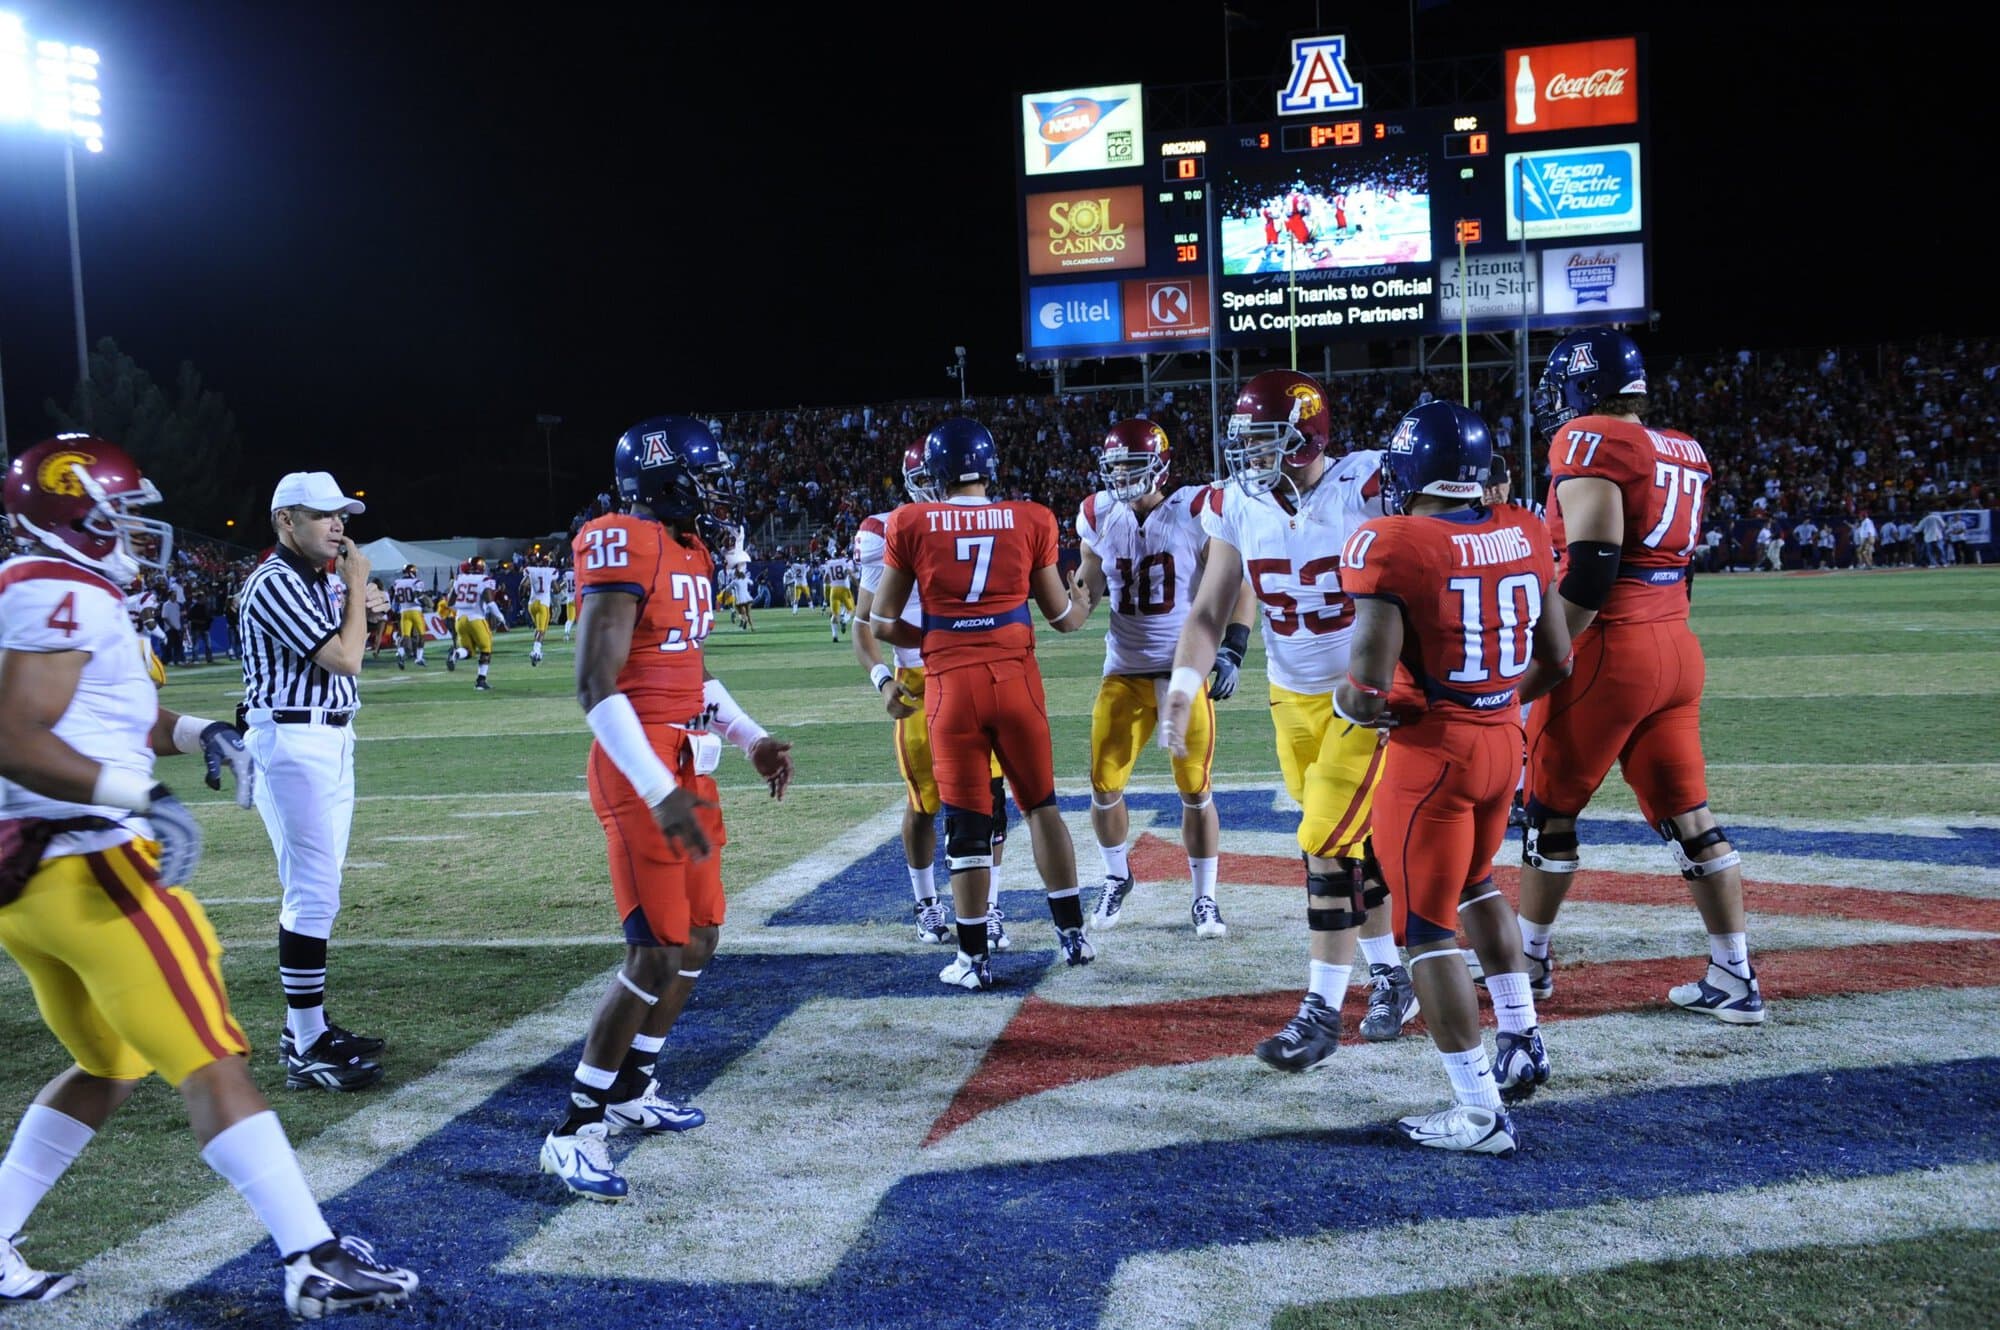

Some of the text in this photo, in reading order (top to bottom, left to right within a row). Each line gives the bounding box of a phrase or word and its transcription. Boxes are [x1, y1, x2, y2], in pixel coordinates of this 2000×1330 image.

[1278, 35, 1363, 115] A
[1545, 68, 1628, 101] Coca-Cola
[1260, 133, 1269, 148] 3
[1311, 122, 1360, 147] 1:49
[1374, 123, 1385, 138] 3
[1161, 140, 1206, 156] ARIZONA
[1179, 159, 1195, 178] 0
[1542, 162, 1605, 181] Tucson
[1549, 175, 1621, 195] Electric
[1049, 198, 1125, 239] SOL
[1556, 193, 1622, 211] Power
[1049, 234, 1126, 255] CASINOS
[1177, 245, 1197, 262] 30
[1222, 288, 1284, 311] Special
[1351, 283, 1369, 299] to
[1372, 278, 1432, 297] Official
[1229, 303, 1424, 332] UA Corporate Partners!
[1567, 342, 1598, 376] A
[640, 430, 677, 469] A
[1392, 417, 1420, 454] A
[1563, 430, 1603, 467] 77
[926, 508, 1014, 533] TUITAMA
[1642, 461, 1711, 557] 77
[585, 527, 628, 569] 32
[1339, 528, 1378, 571] 10
[1451, 526, 1532, 567] THOMAS
[537, 576, 545, 593] 1
[955, 535, 995, 604] 7
[1115, 551, 1176, 616] 10
[1247, 555, 1357, 637] 53
[45, 591, 80, 638] 4
[952, 617, 995, 629] ARIZONA
[1448, 572, 1542, 683] 10
